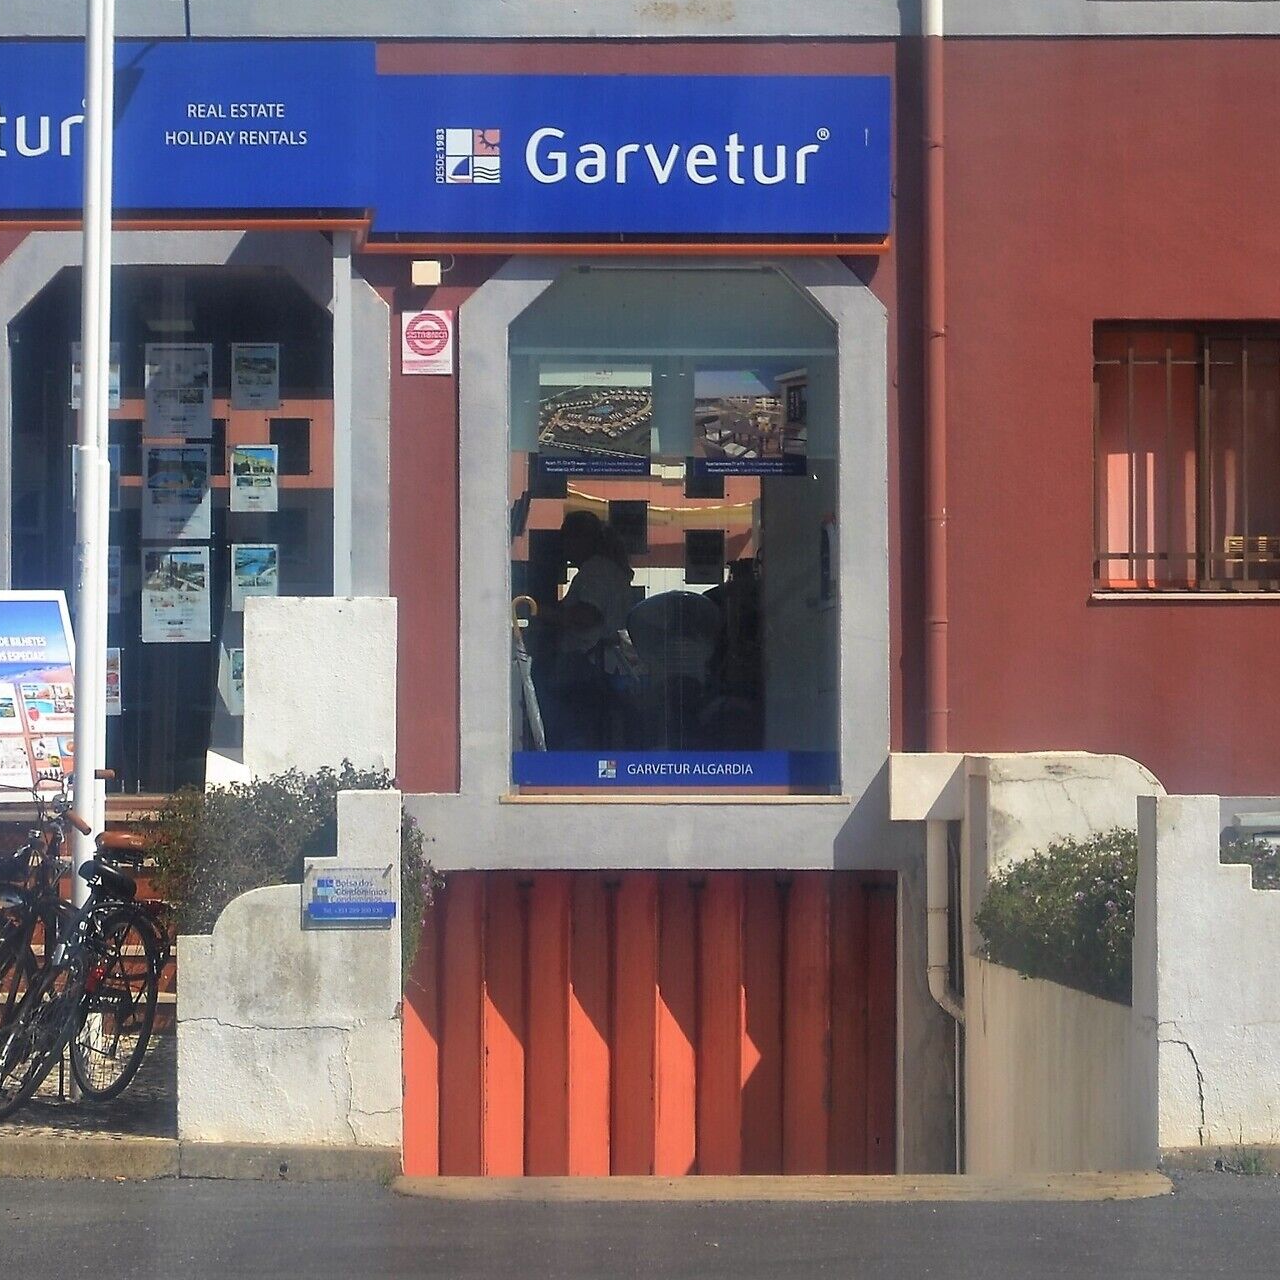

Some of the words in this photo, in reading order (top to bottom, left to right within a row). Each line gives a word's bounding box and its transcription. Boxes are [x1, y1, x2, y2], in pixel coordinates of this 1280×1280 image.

[187, 103, 226, 118] REAL
[230, 103, 285, 118] ESTATE
[165, 131, 236, 145] HOLIDAY
[239, 131, 308, 145] RENTALS
[435, 128, 445, 152] 1983
[435, 154, 445, 184] DESDE
[627, 763, 690, 775] GARVETUR
[693, 763, 753, 775] ALGARDIA
